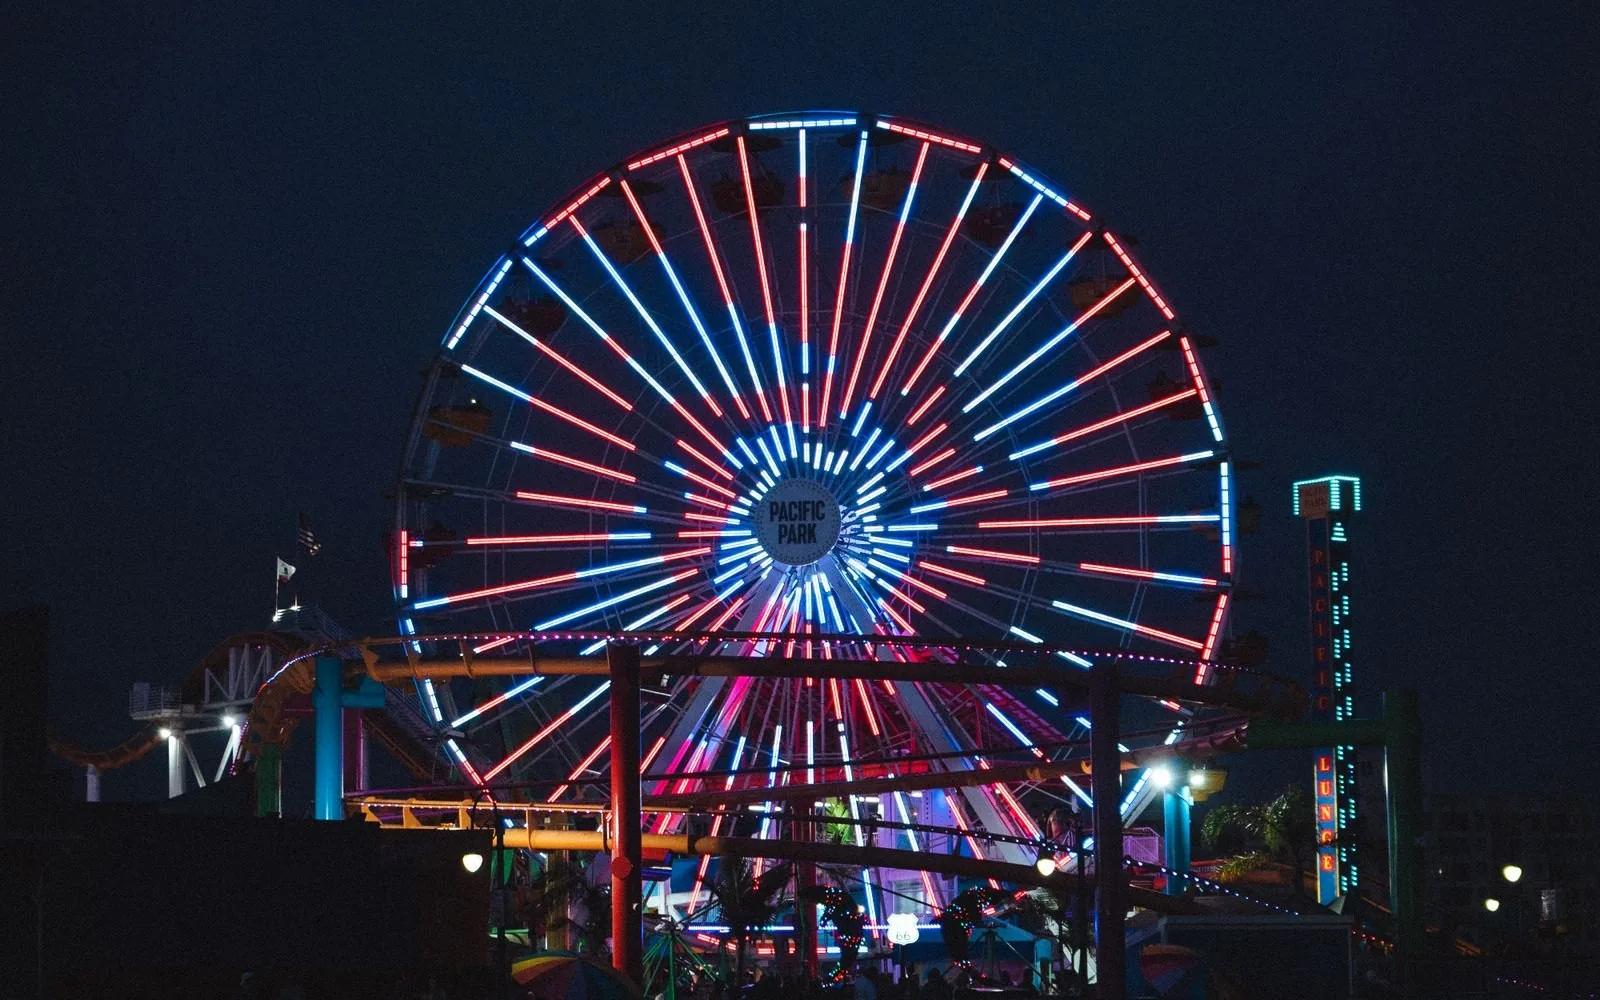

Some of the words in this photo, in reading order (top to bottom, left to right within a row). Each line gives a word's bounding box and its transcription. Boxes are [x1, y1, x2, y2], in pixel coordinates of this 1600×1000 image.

[769, 500, 826, 522] PACIFIC
[778, 523, 817, 545] PARK
[1314, 550, 1329, 708] PACIFIC
[1319, 756, 1333, 870] LUNGE
[896, 931, 911, 941] 66
